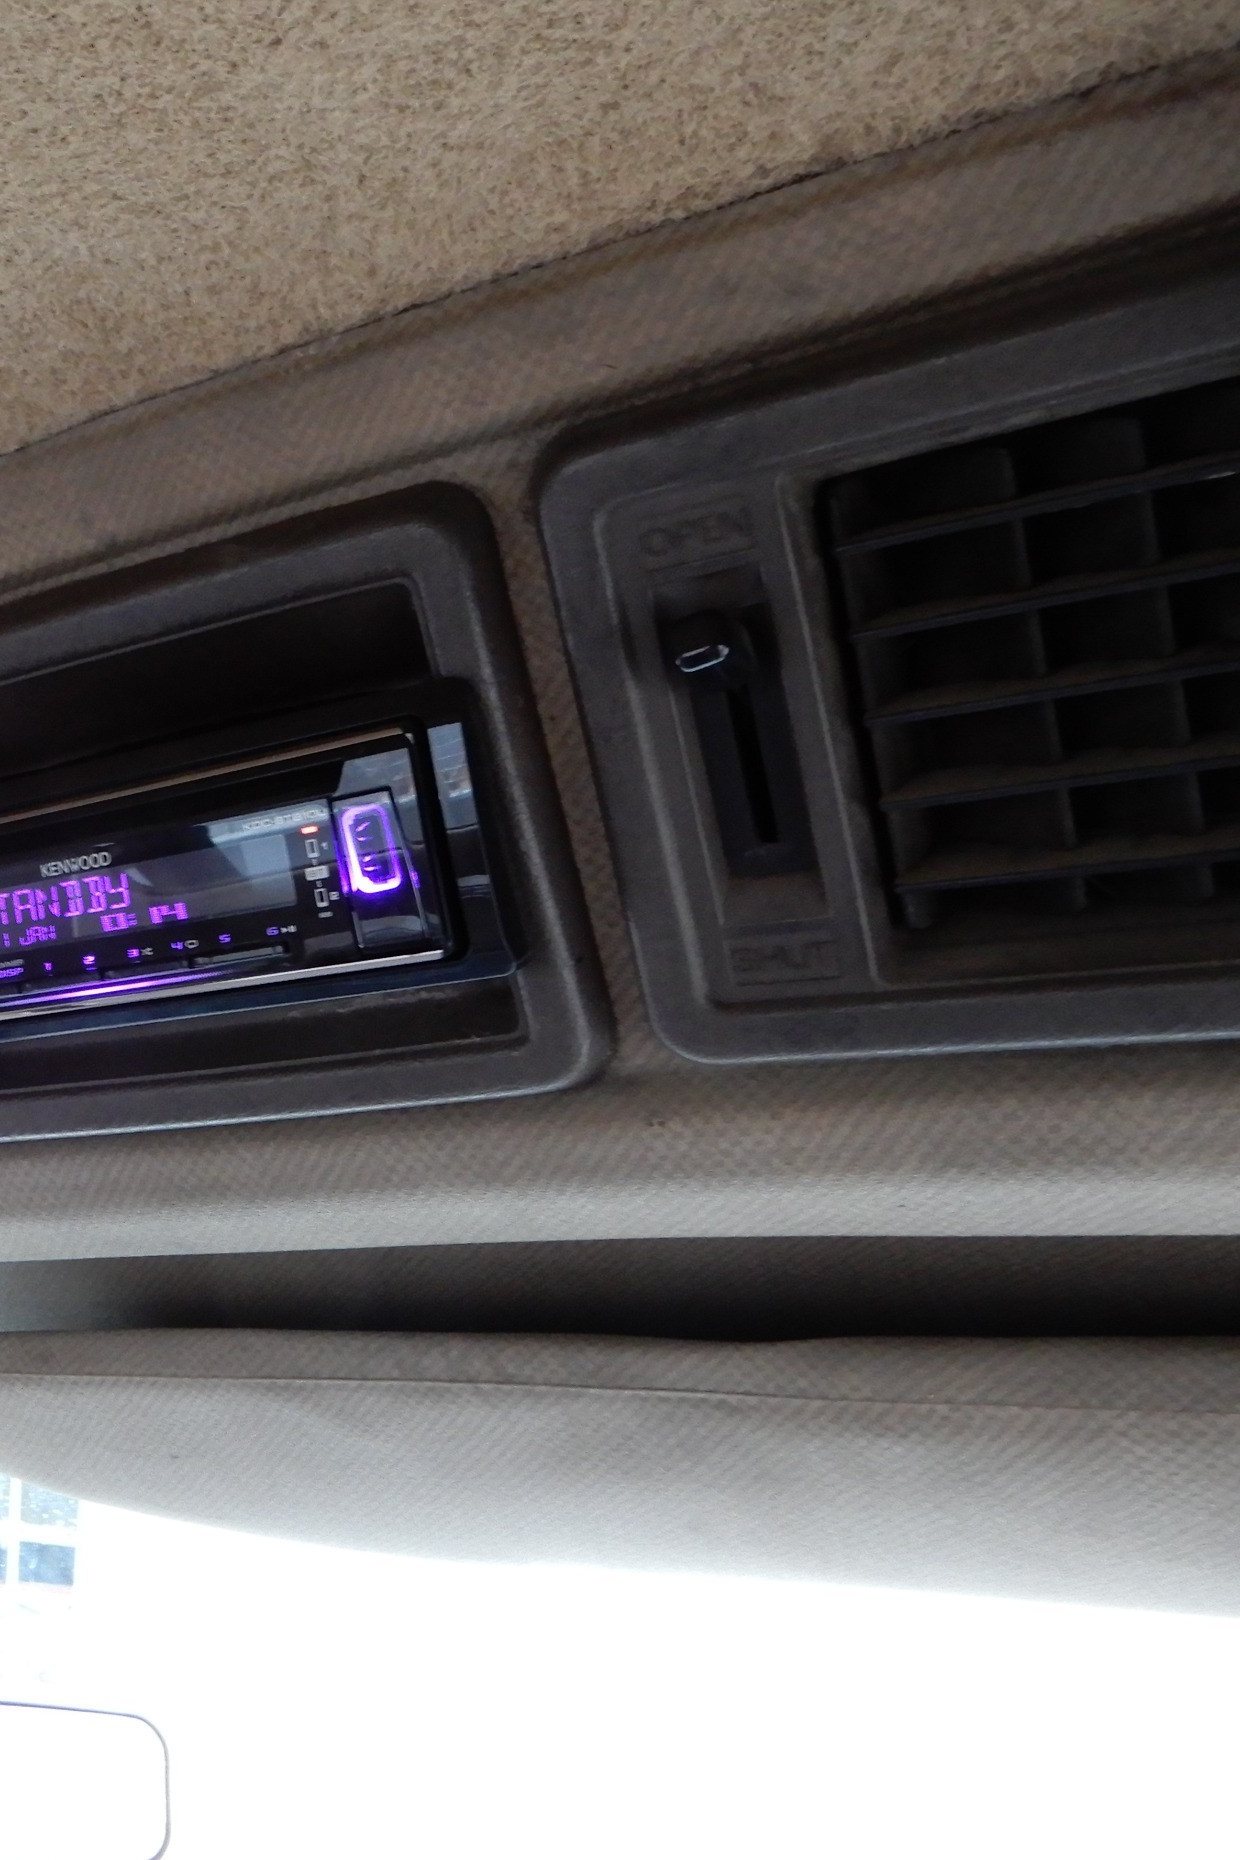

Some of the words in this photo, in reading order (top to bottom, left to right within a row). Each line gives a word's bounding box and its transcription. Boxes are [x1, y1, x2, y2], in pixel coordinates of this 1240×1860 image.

[638, 507, 754, 557] OPEN
[39, 851, 113, 878] KENWOOD
[19, 924, 57, 946] JAN
[82, 954, 96, 966] 2
[127, 948, 140, 958] 3
[170, 941, 184, 951] 4
[218, 934, 231, 944] 5
[266, 926, 279, 936] 6
